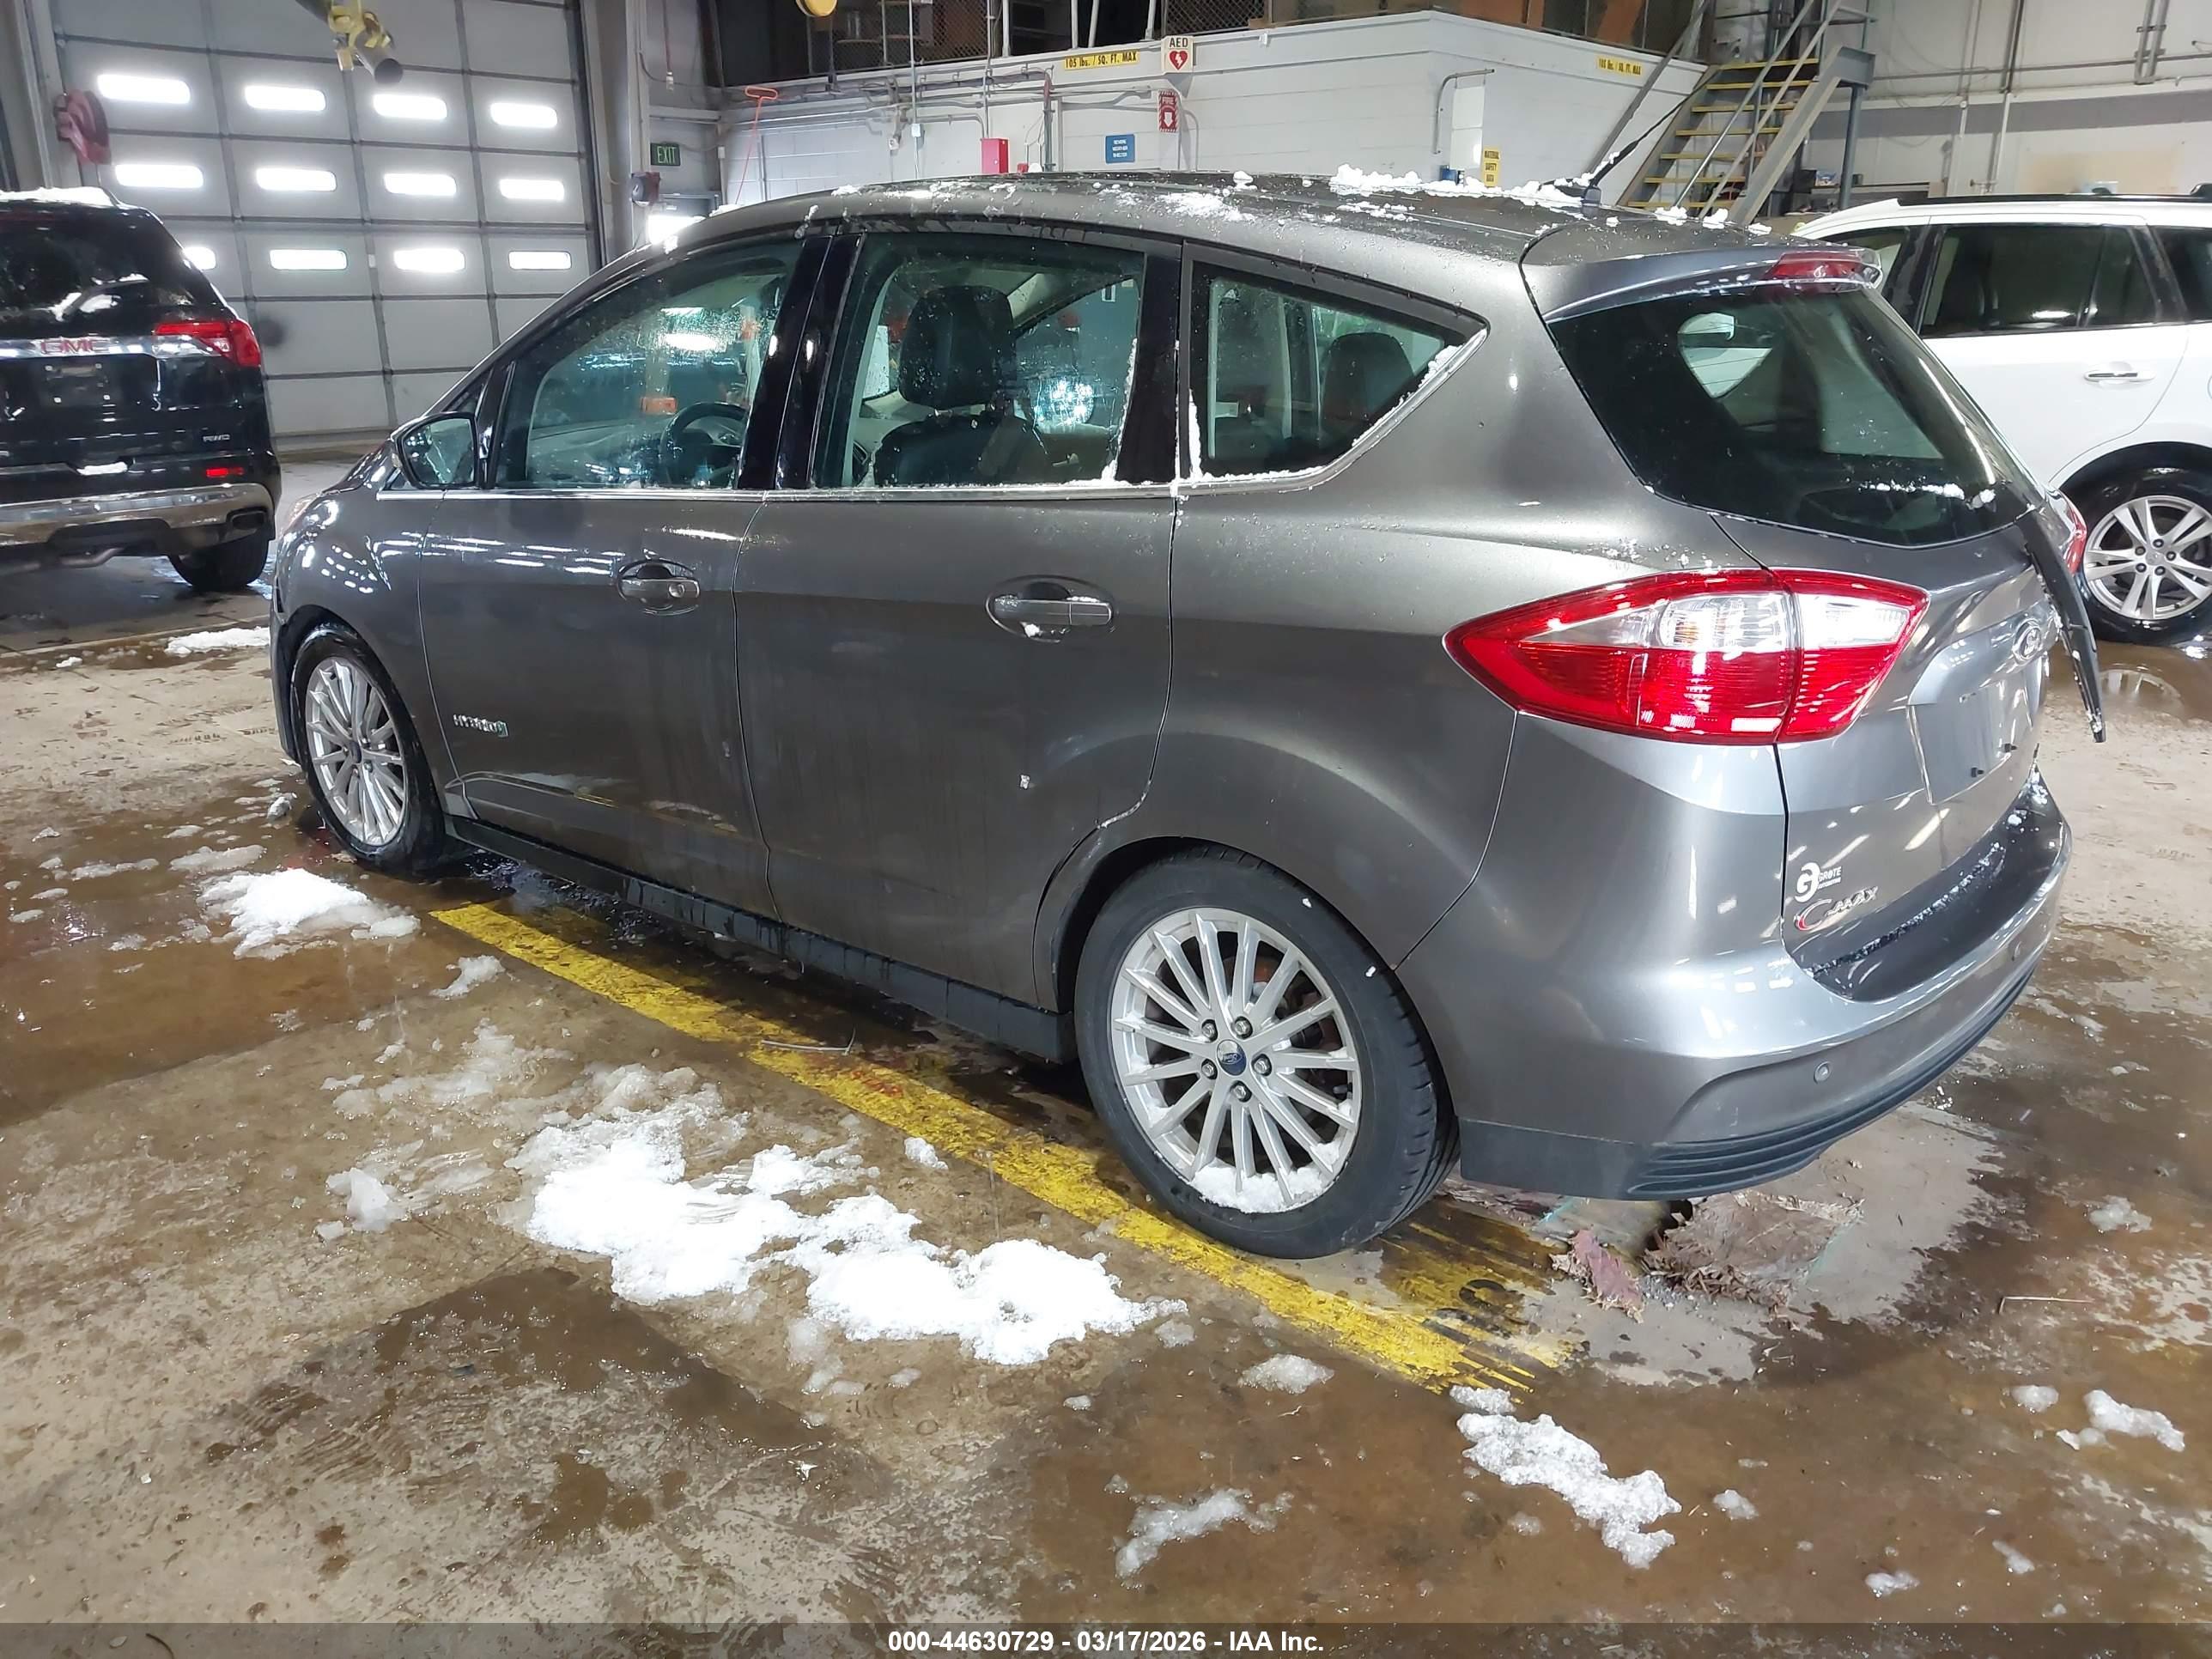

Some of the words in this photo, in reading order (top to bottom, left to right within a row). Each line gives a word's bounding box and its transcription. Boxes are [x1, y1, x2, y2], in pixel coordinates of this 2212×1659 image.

[1169, 37, 1188, 47] AED
[1066, 58, 1077, 69] 105
[1079, 57, 1091, 67] lbs.
[1097, 55, 1108, 65] SQ.
[1110, 54, 1120, 64] FT.
[1122, 52, 1137, 63] MAX
[657, 145, 677, 164] EXIT
[40, 337, 110, 355] GMC
[453, 714, 498, 732] HYBRID
[1819, 866, 1842, 883] GROTE
